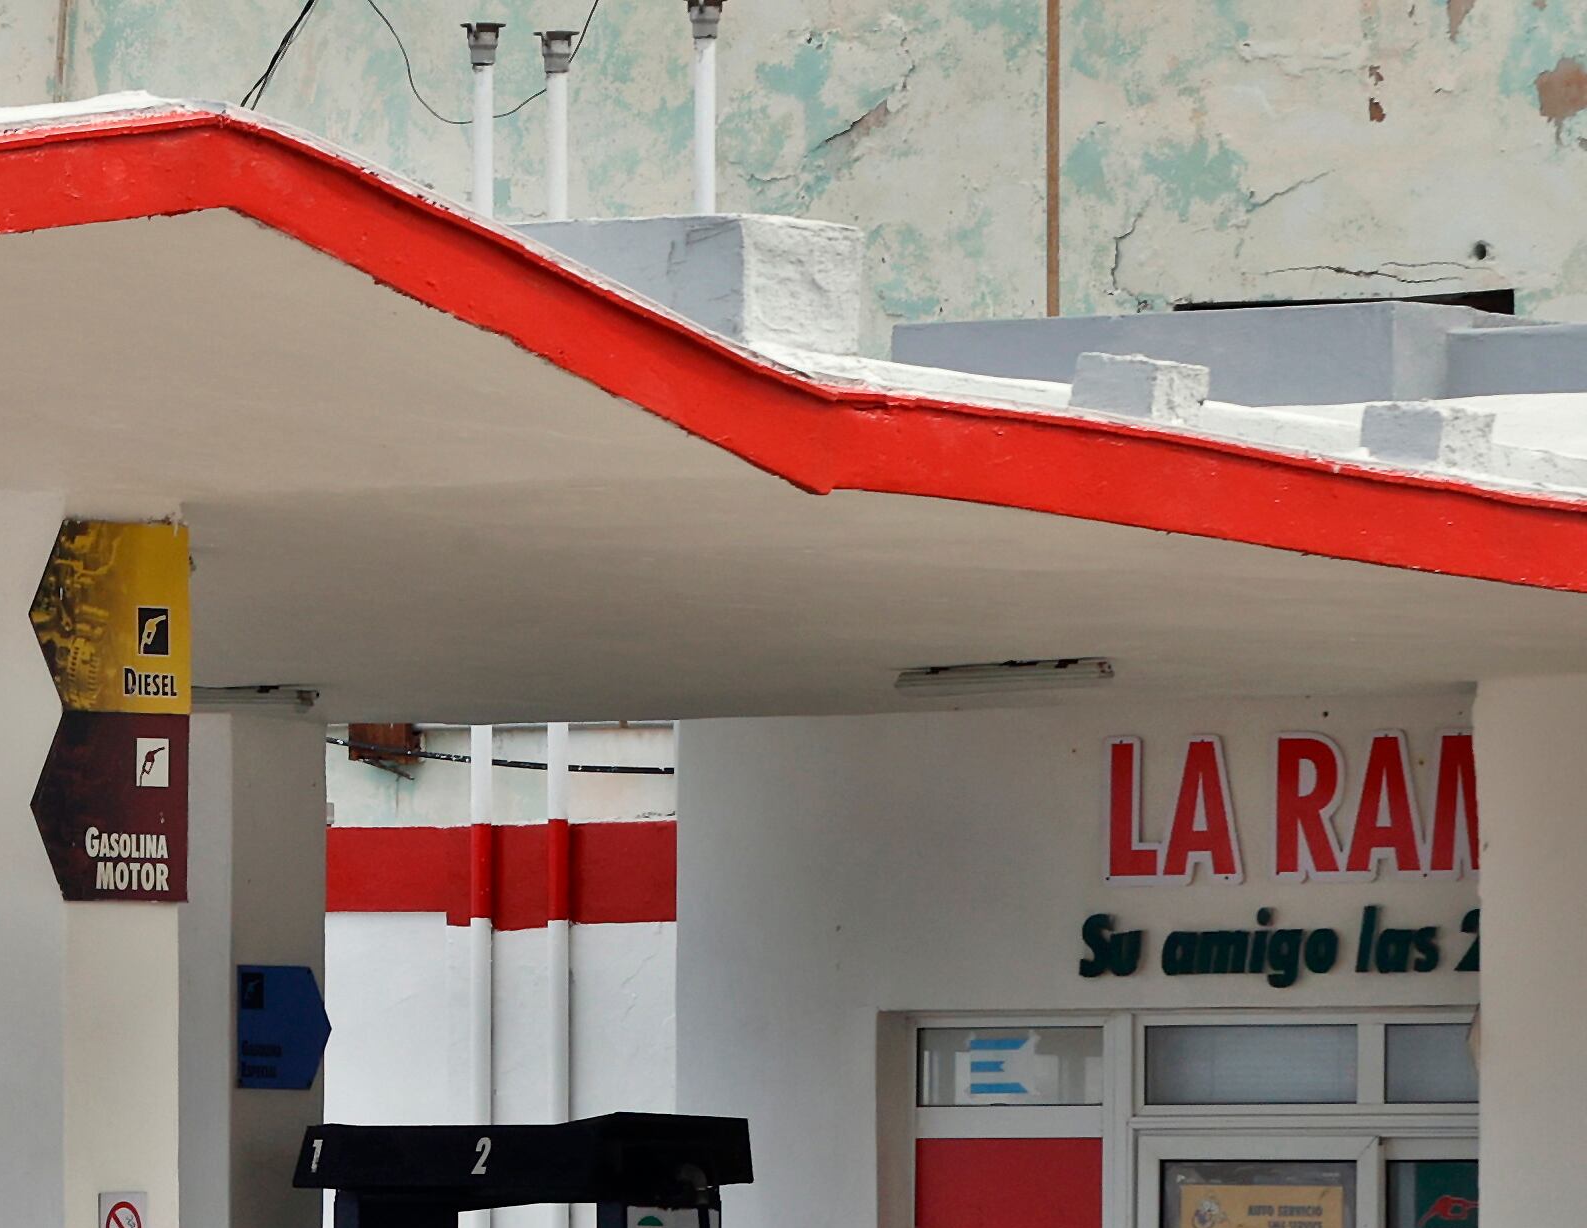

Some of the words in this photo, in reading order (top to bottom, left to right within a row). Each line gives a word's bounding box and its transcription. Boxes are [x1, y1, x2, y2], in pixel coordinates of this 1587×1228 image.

[123, 666, 177, 697] DIESEL
[1109, 741, 1237, 876] LA
[84, 826, 169, 860] GASOLINA
[96, 861, 169, 891] MOTOR
[1078, 913, 1144, 978] Su
[1161, 907, 1338, 989] amigo
[1355, 905, 1440, 973] las
[311, 1139, 323, 1172] 1
[471, 1137, 492, 1175] 2
